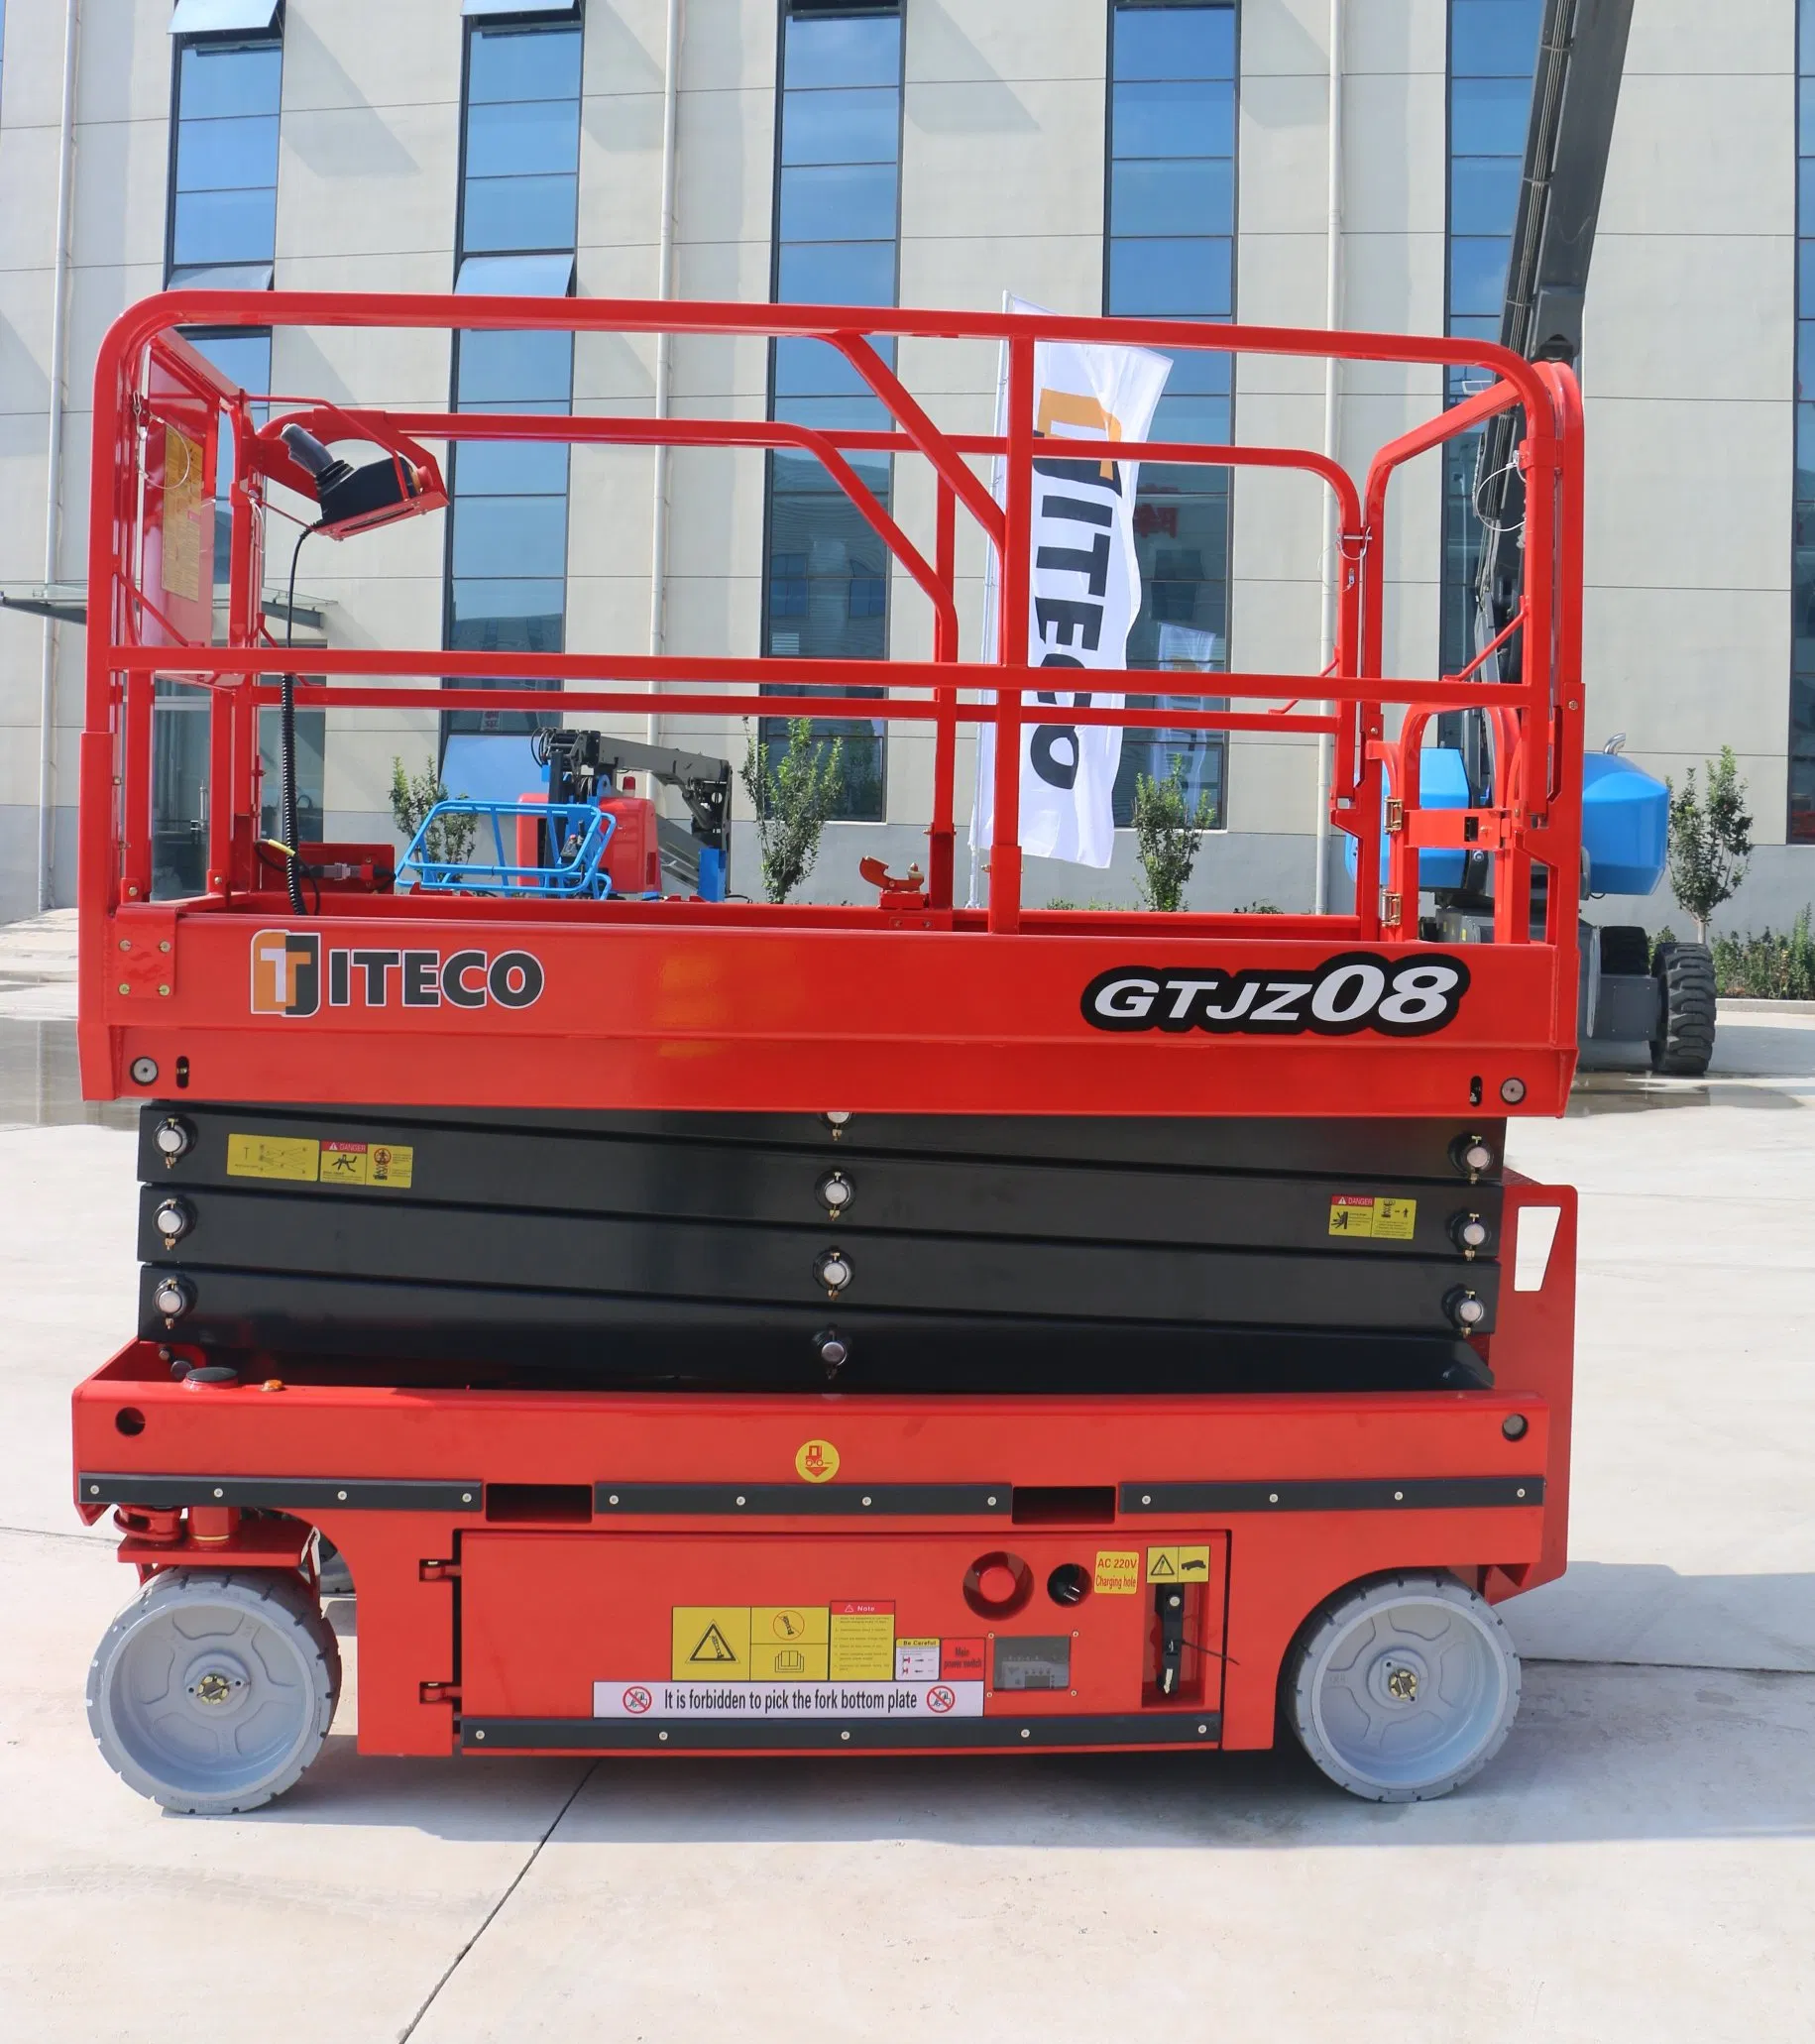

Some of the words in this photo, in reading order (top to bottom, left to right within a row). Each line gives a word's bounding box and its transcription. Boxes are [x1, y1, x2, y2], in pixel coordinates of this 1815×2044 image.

[328, 949, 544, 1009] ITECO
[1093, 964, 1459, 1023] GTJZ08
[339, 1142, 367, 1152] DANGER
[1348, 1196, 1373, 1205] DANGER
[1097, 1558, 1111, 1568] AC
[1113, 1558, 1138, 1569] 220V
[1095, 1574, 1122, 1590] Charging
[1123, 1575, 1137, 1588] hole
[664, 1689, 673, 1709] It
[676, 1689, 686, 1709] is
[689, 1689, 745, 1709] forbidden
[748, 1690, 762, 1709] to
[764, 1689, 789, 1714] pick
[792, 1689, 812, 1709] the
[814, 1689, 839, 1709] fork
[841, 1689, 884, 1709] bottom
[887, 1689, 918, 1713] plate
